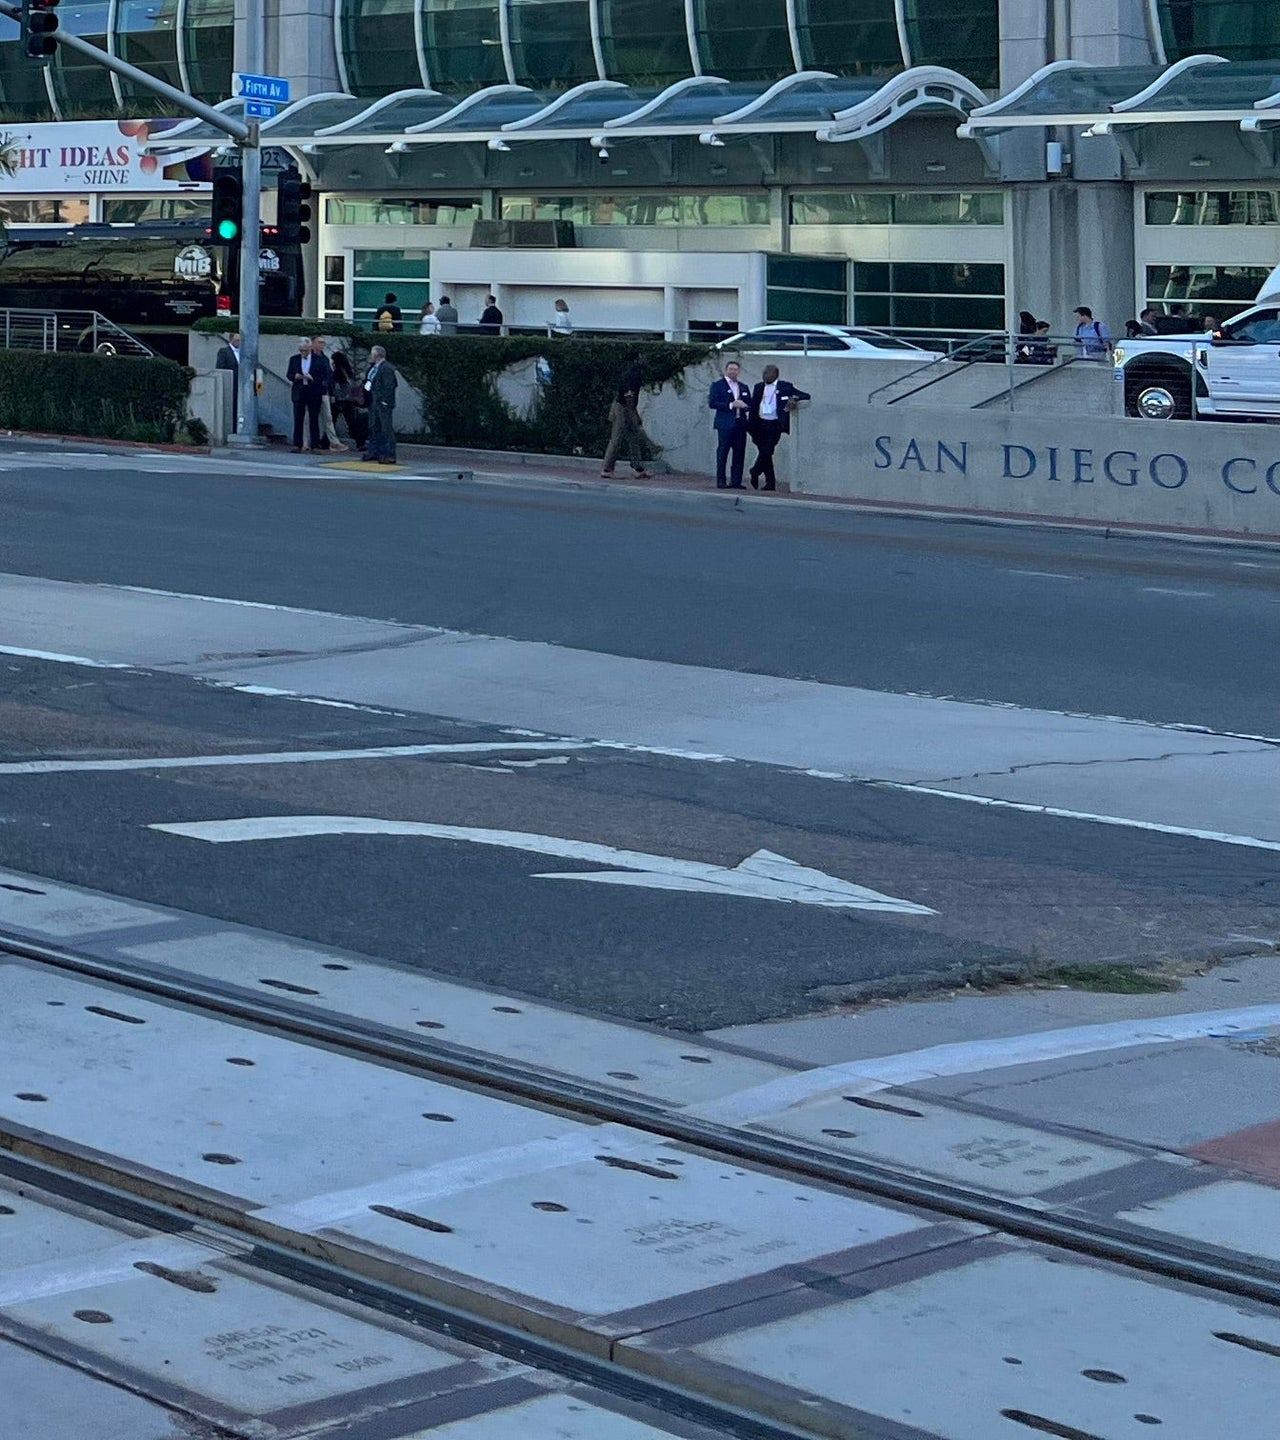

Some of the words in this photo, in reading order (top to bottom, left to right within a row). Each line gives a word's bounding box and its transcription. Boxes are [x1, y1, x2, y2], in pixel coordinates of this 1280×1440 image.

[245, 79, 268, 95] FIFTH
[60, 145, 130, 168] IDEAS
[83, 168, 130, 186] SHINE
[873, 435, 968, 476] SAN
[1000, 443, 1189, 490] DIEGO
